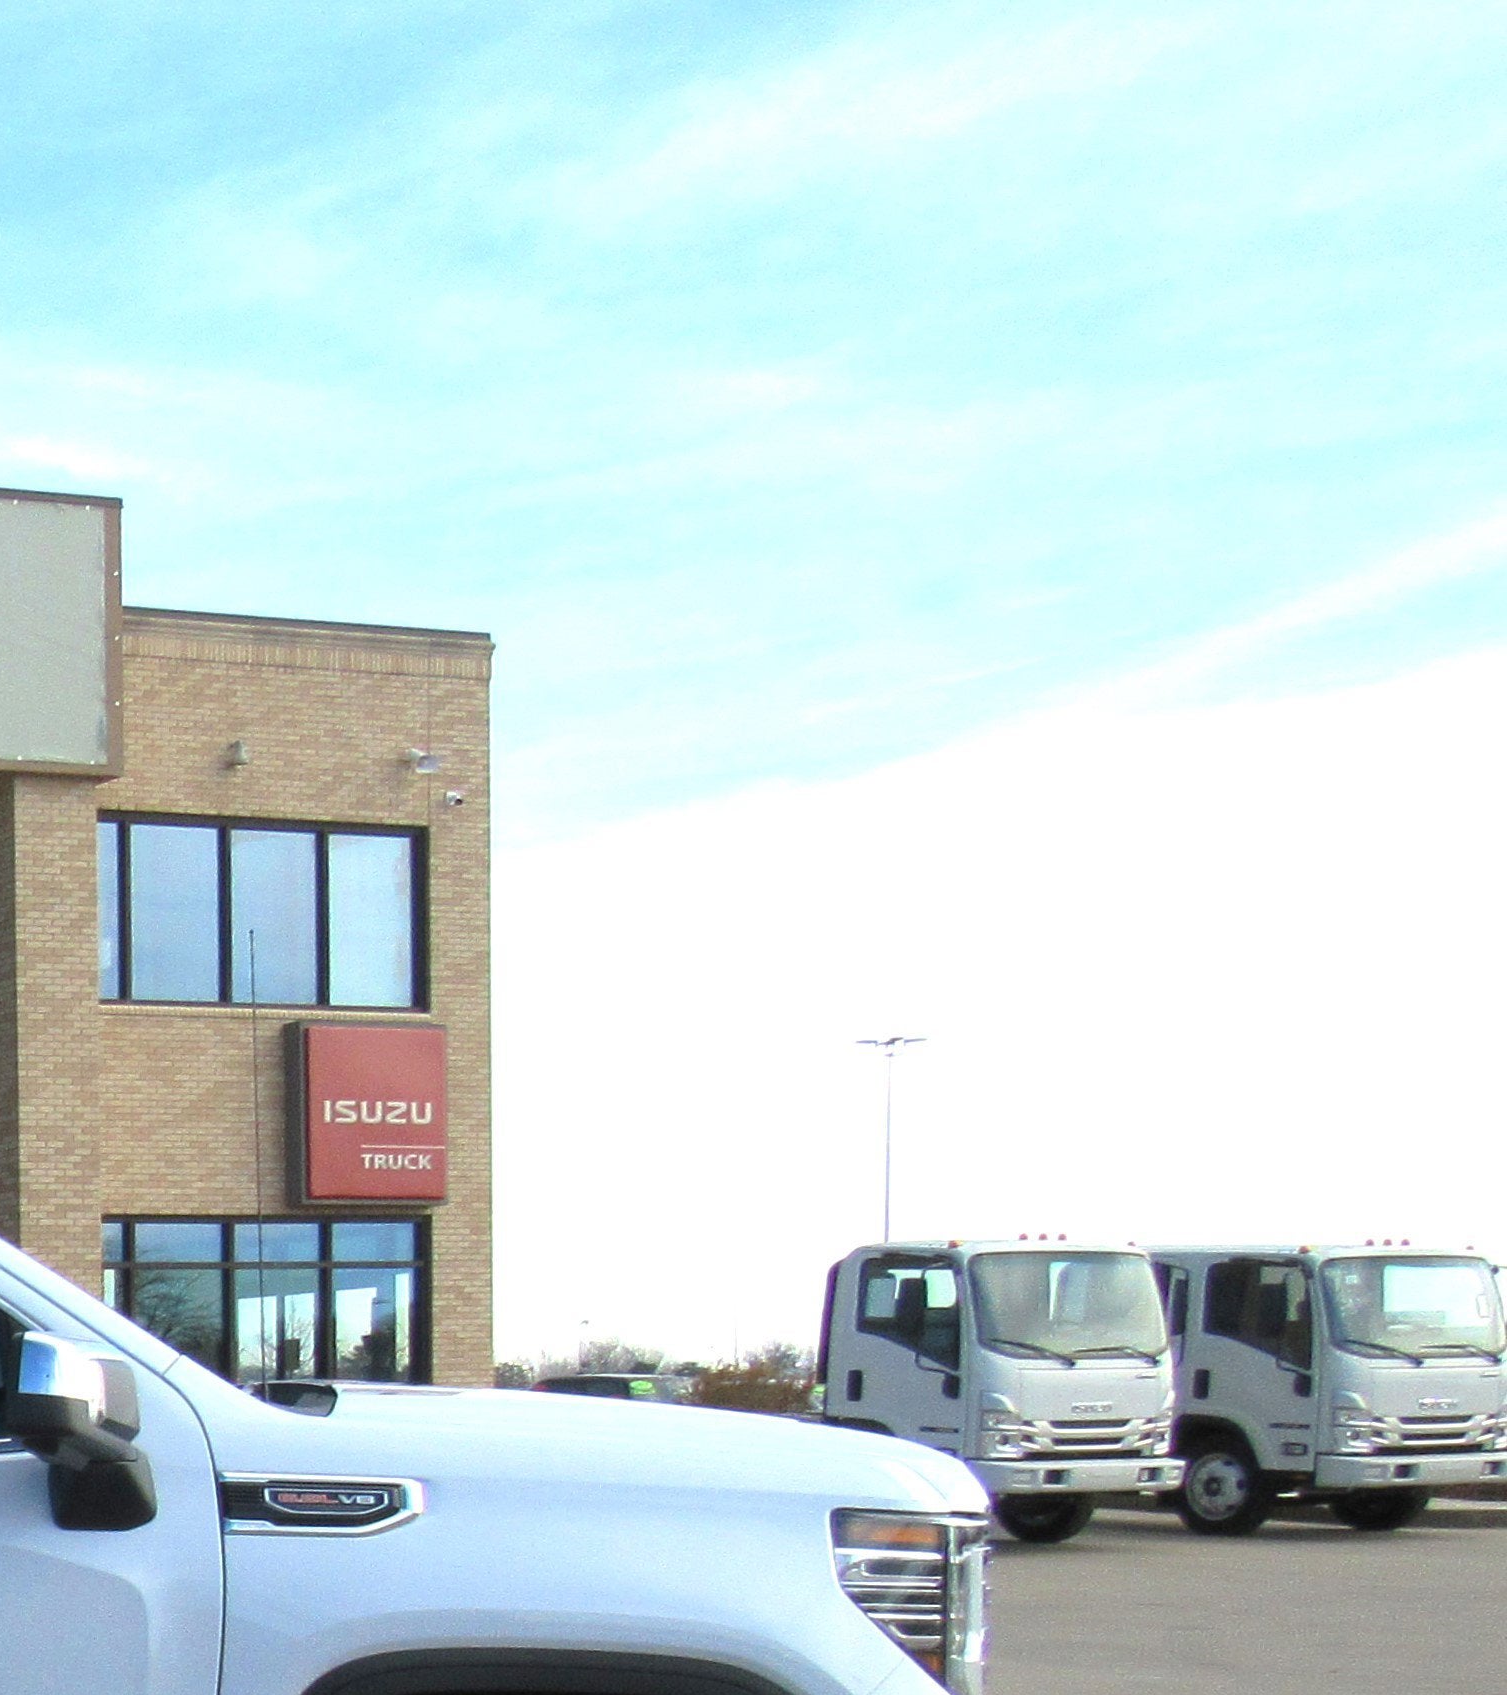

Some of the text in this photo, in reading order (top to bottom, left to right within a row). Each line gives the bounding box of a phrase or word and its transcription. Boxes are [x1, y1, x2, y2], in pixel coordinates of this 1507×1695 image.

[322, 1099, 433, 1125] ISUZU
[360, 1153, 433, 1170] TRUCK
[337, 1493, 377, 1506] V8
